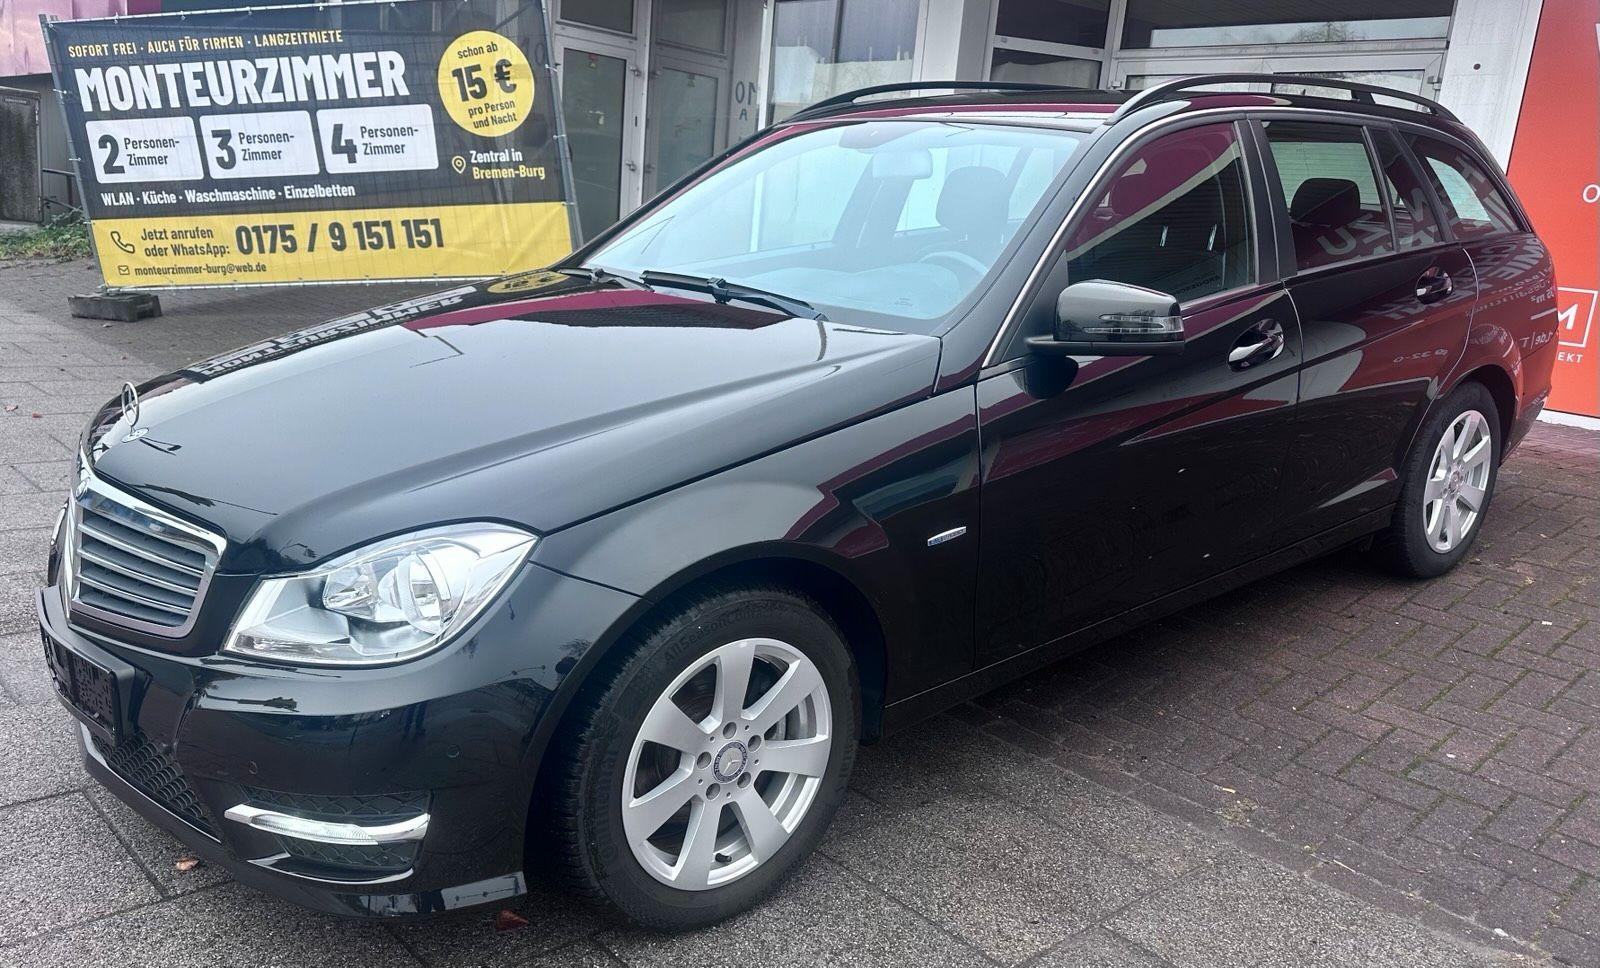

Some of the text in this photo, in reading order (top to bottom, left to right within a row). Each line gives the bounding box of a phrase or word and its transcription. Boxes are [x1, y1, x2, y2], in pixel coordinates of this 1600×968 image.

[68, 30, 343, 58] SOFORT FREI AUCH FÜR FIRMEN LANGZEITMIETE
[457, 42, 498, 59] schon ab
[74, 50, 410, 112] MONTEURZIMMER
[451, 58, 517, 102] 15 €
[468, 100, 516, 118] pro Person
[473, 112, 517, 129] und Nacht
[211, 129, 295, 170] 3 Personen-
[331, 123, 419, 164] 4 Personen-
[362, 142, 406, 156] Zimmer
[98, 134, 180, 175] 2 Personen-
[126, 153, 168, 167] Zimmer
[241, 148, 282, 161] Zimmer
[469, 147, 523, 164] Zentral in
[472, 164, 546, 180] Bremen-Burg
[101, 184, 356, 206] WLAN Küche Waschmaschine Einzelbetten
[141, 226, 214, 241] Jetzt anrufen
[235, 218, 445, 256] 0175 / 9 151 151
[144, 242, 230, 258] oder WhatsApp:
[135, 262, 267, 277] monteurzimmer-burg@web.de
